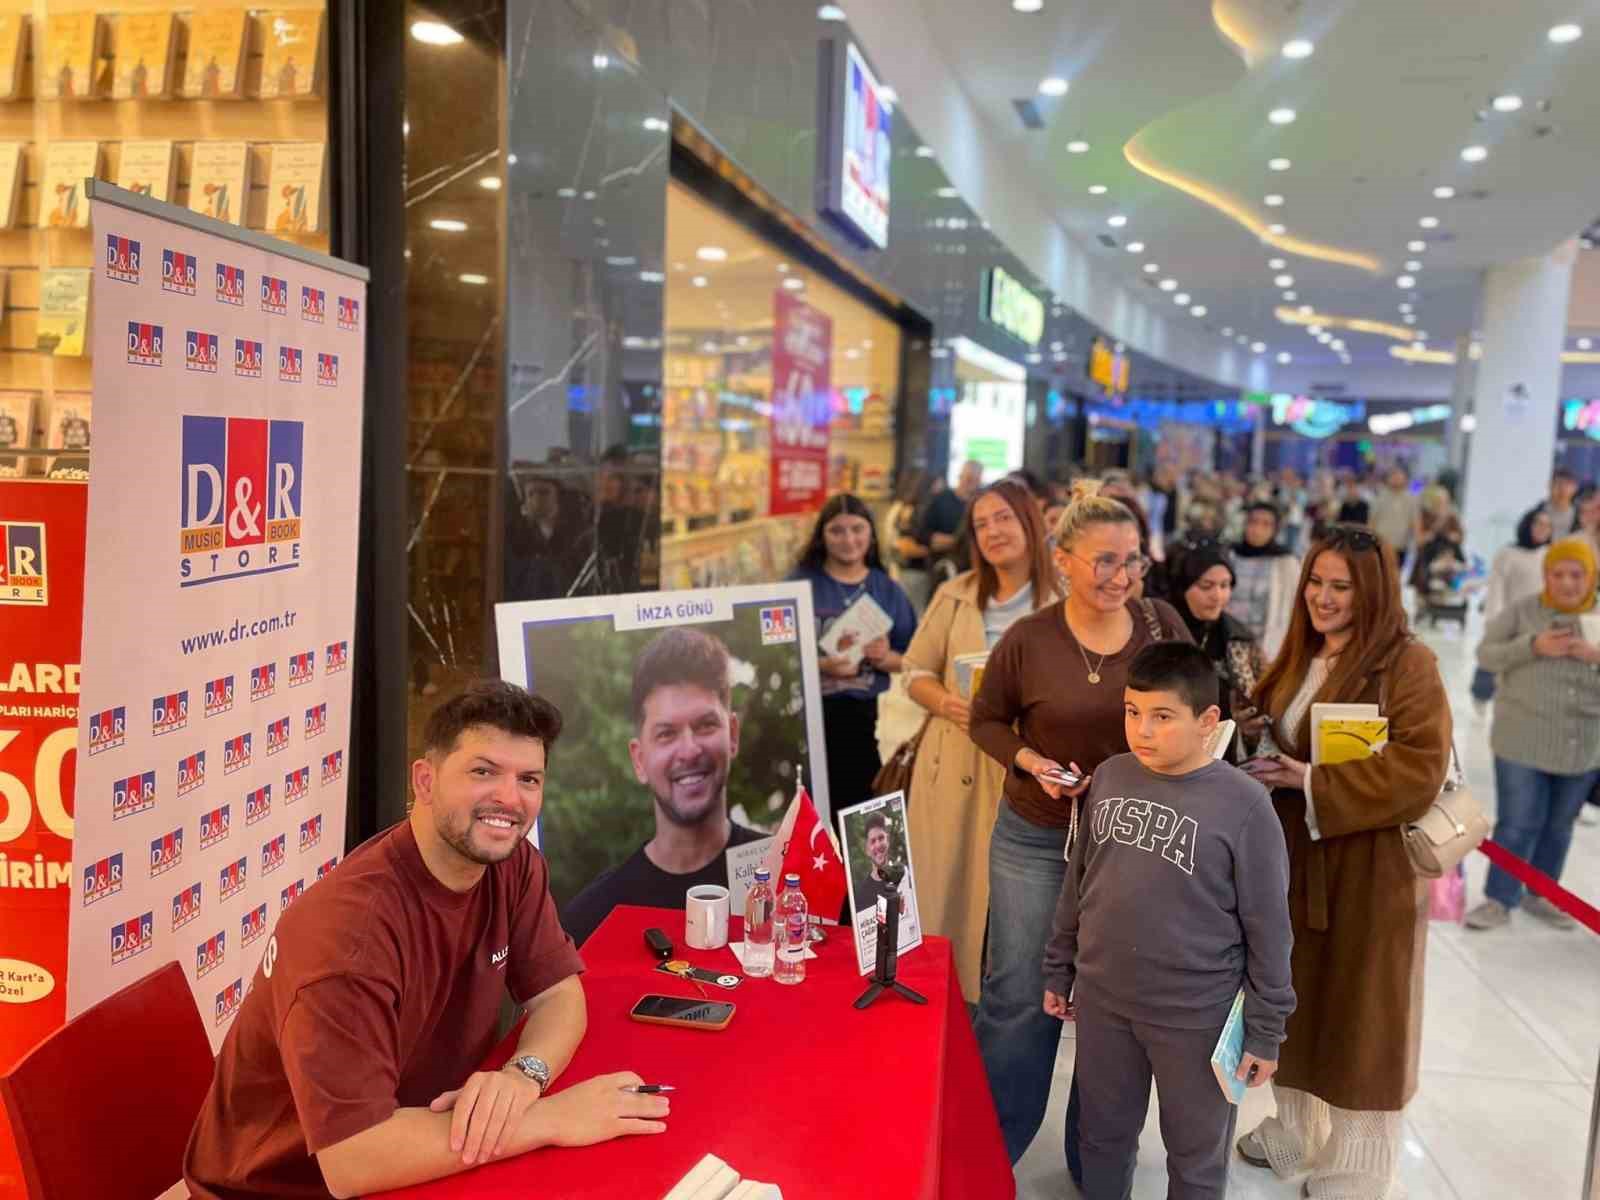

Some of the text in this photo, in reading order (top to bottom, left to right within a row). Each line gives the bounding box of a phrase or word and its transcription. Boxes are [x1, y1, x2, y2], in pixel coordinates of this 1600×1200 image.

[186, 463, 296, 539] D&R
[184, 523, 297, 550] MUSIC BOOK
[181, 543, 300, 577] STORE
[636, 599, 713, 621] İMZA GÜNÜ
[181, 610, 297, 655] www.dr.com.tr
[1091, 797, 1199, 876] USPA
